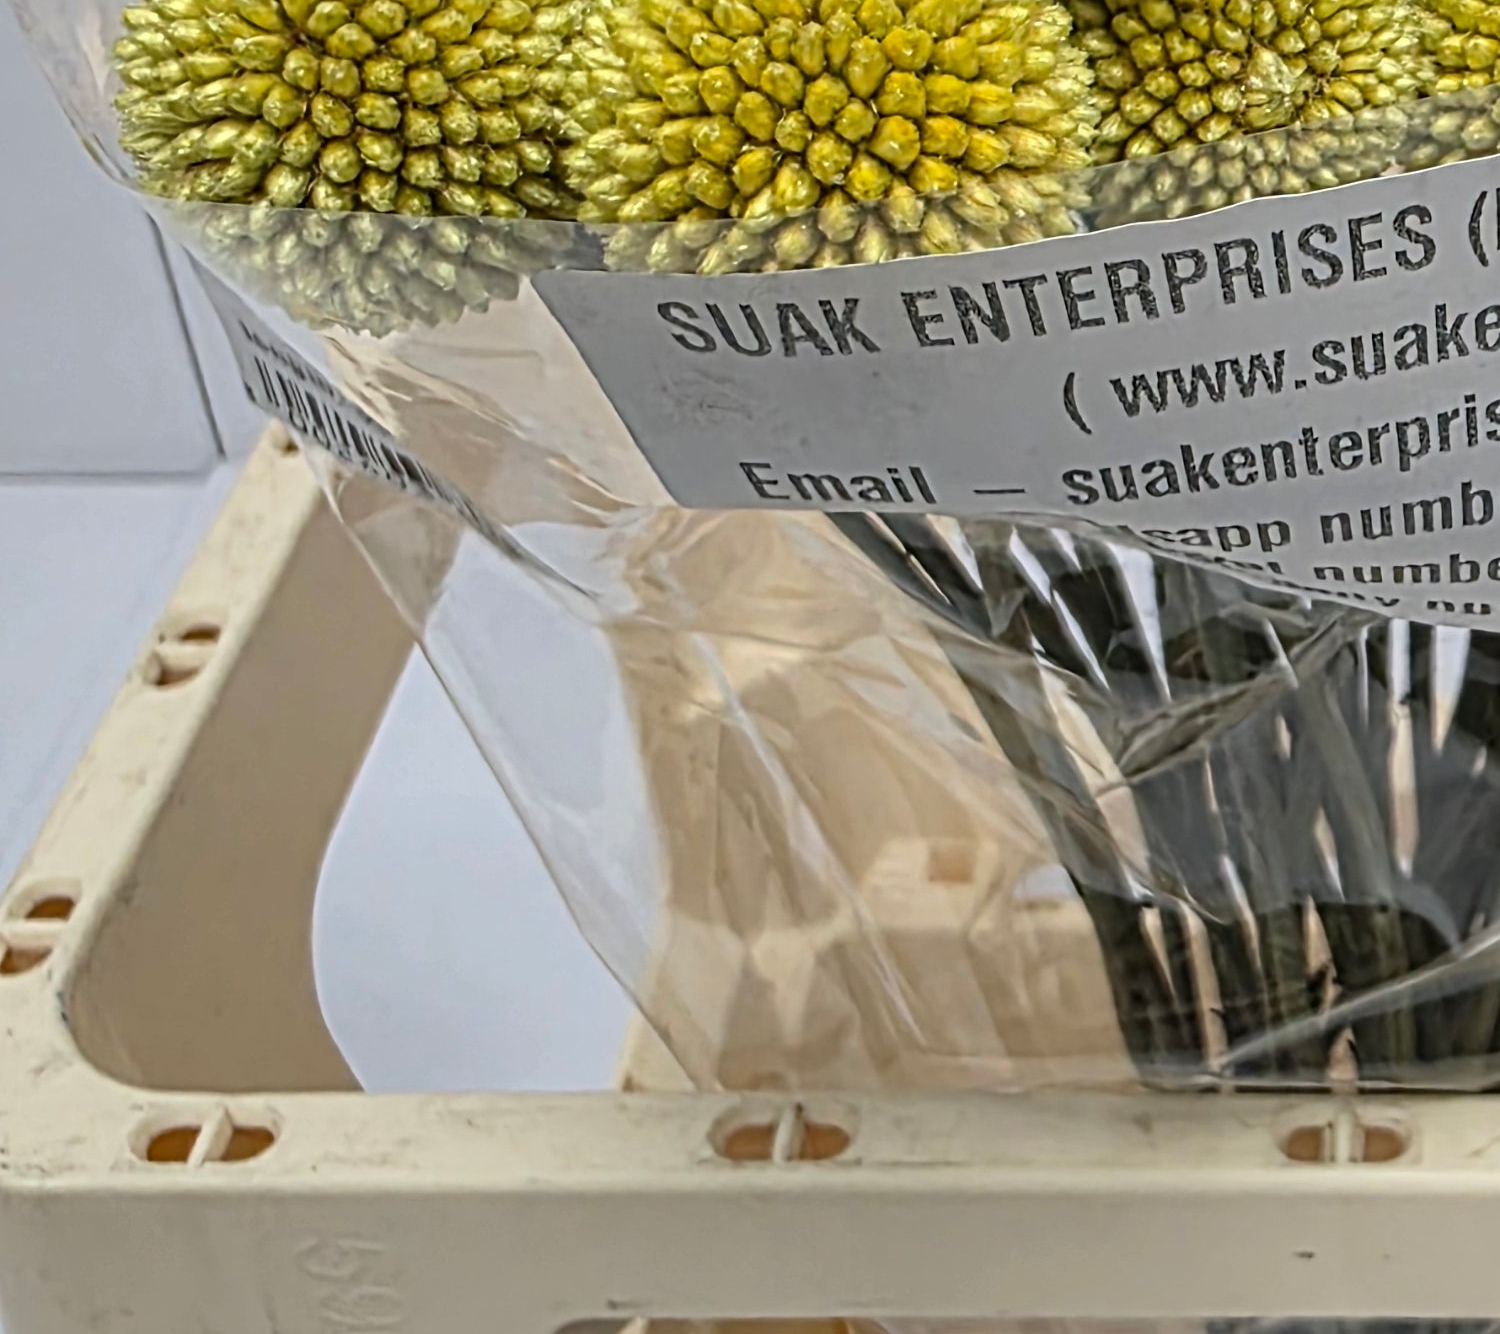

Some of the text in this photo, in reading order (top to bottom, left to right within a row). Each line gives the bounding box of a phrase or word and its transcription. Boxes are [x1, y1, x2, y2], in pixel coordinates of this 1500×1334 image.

[657, 298, 881, 357] SUAK
[900, 202, 1437, 347] ENTERPRISES
[739, 461, 937, 504] Email
